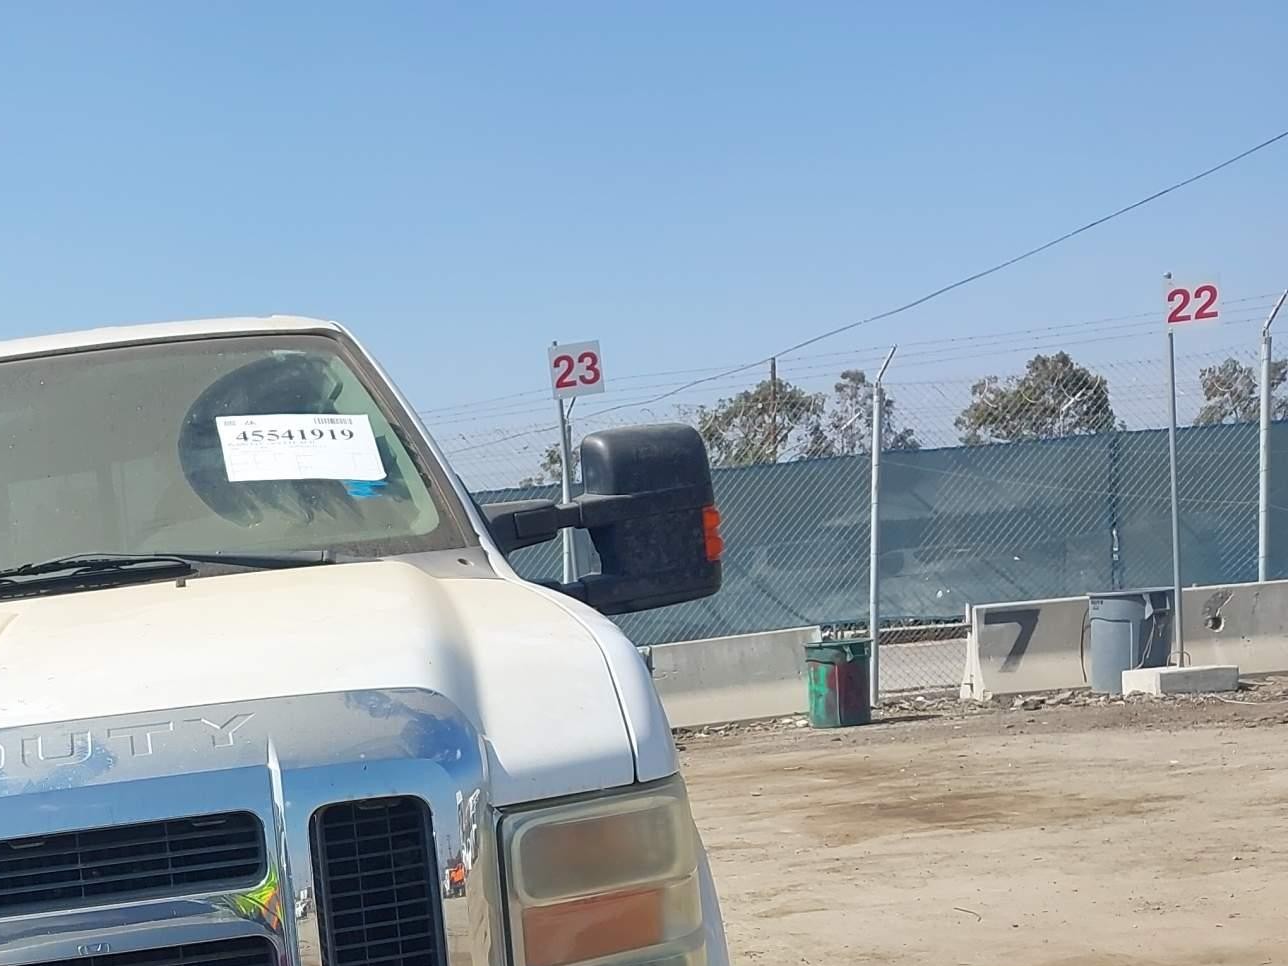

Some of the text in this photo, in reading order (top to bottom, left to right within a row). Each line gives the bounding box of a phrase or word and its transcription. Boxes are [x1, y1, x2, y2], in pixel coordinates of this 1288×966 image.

[1167, 284, 1219, 323] 22
[553, 351, 601, 389] 23
[235, 428, 355, 442] 45541919
[983, 607, 1042, 673] 7
